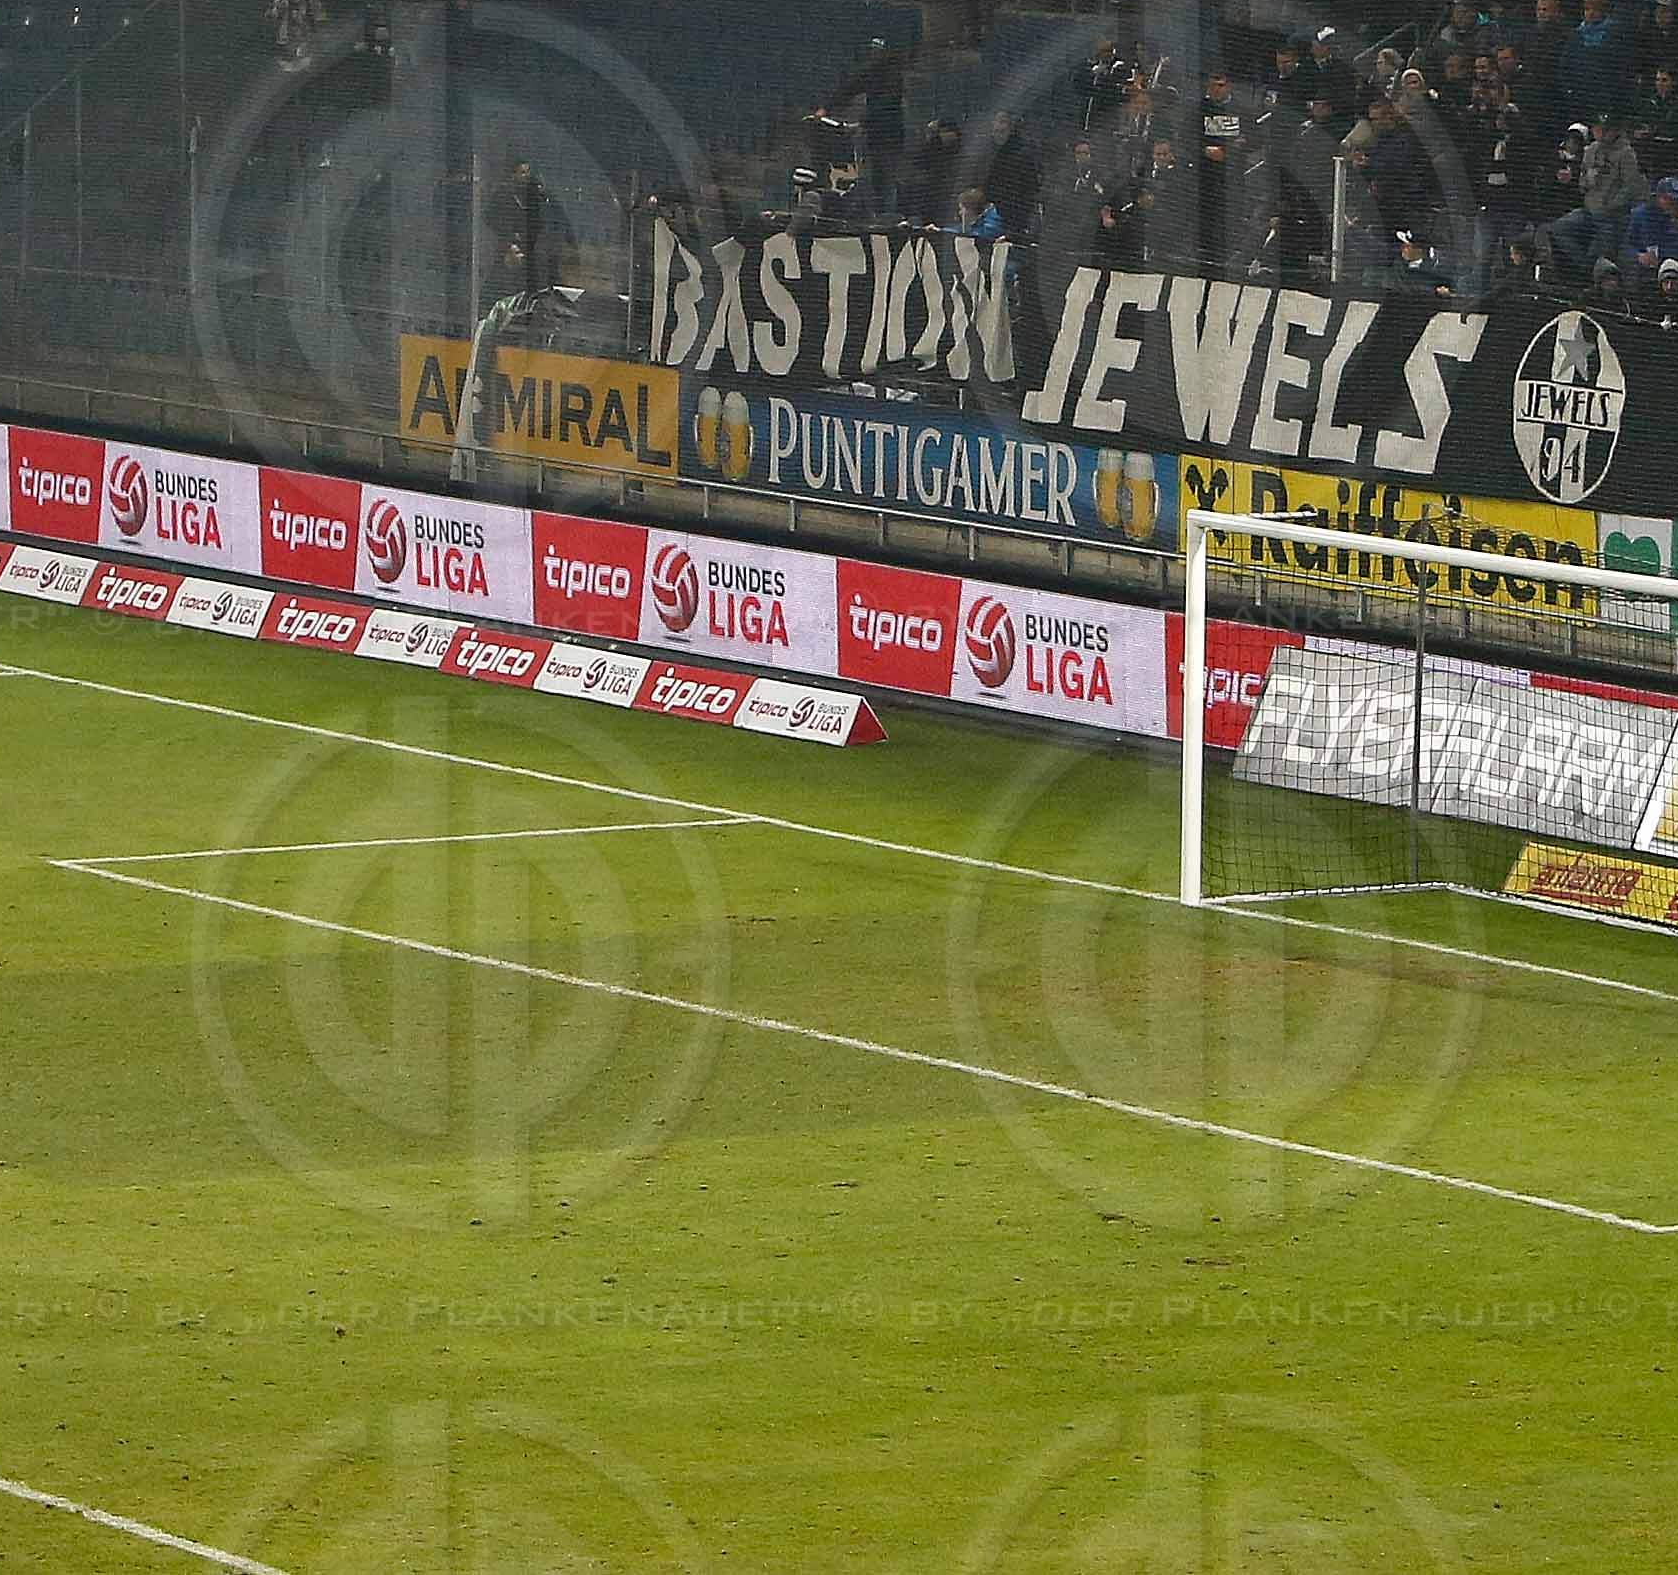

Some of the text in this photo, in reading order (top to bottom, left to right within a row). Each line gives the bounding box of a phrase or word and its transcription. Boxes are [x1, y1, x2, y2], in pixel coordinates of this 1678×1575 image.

[648, 217, 1017, 384] BASTION
[1021, 266, 1490, 475] JEWELS
[1521, 380, 1612, 423] JEWELS
[18, 458, 91, 506] tipico
[767, 397, 1079, 528] PUNTIGAMER
[1539, 433, 1581, 484] 94
[154, 470, 219, 502] BUNDES
[155, 498, 224, 551] LIGA
[269, 500, 347, 551] tipico
[413, 515, 485, 549] BUNDES
[1249, 470, 1586, 609] Raiffeisen
[9, 559, 40, 580] tipico
[53, 573, 82, 594] LIGA
[98, 565, 169, 612] tipico
[415, 544, 490, 598] LIGA
[542, 544, 631, 601] tipico
[707, 561, 786, 597] BUNDES
[178, 592, 211, 613] tipico
[227, 604, 258, 627] LIGA
[277, 596, 356, 644] tipico
[708, 590, 790, 648] LIGA
[848, 594, 942, 654] tipico
[370, 623, 406, 645] tipico
[424, 637, 449, 656] LIG
[454, 631, 535, 679] tipico
[1024, 614, 1111, 654] BUNDES
[546, 656, 582, 680] tipico
[600, 673, 632, 698] LIGA
[652, 666, 737, 715] tipico
[1026, 647, 1114, 707] LIGA
[747, 695, 788, 720] tipico
[807, 710, 843, 736] LIGA
